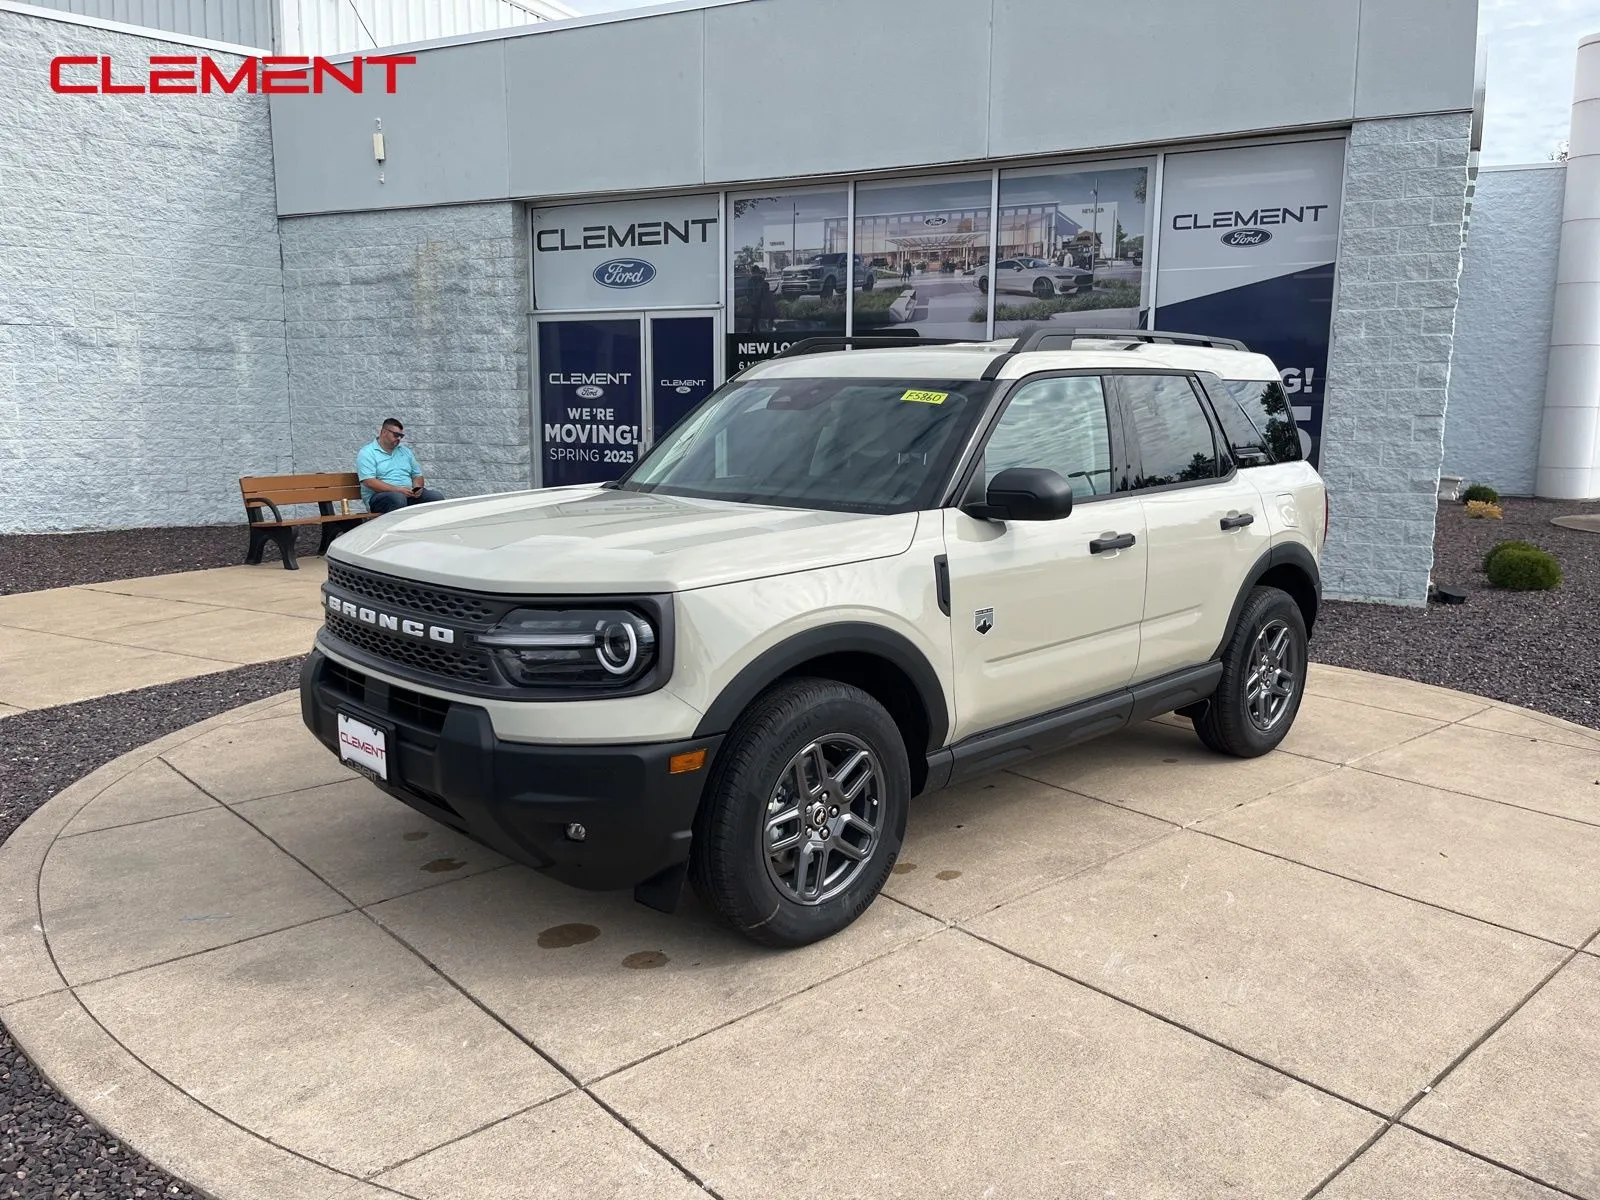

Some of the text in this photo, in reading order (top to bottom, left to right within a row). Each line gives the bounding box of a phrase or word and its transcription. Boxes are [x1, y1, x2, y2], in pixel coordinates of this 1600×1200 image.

[1172, 205, 1328, 230] CLEMENT
[537, 218, 718, 252] CLEMENT
[1227, 230, 1265, 246] Ford
[602, 261, 647, 285] Ford
[738, 342, 770, 354] NEW
[549, 373, 631, 384] CLEMENT
[567, 407, 614, 420] WE'RE
[544, 423, 639, 445] MOVING!
[550, 447, 634, 463] SPRING 2025
[329, 596, 454, 644] BRONCO
[340, 731, 386, 760] CLEMENT
